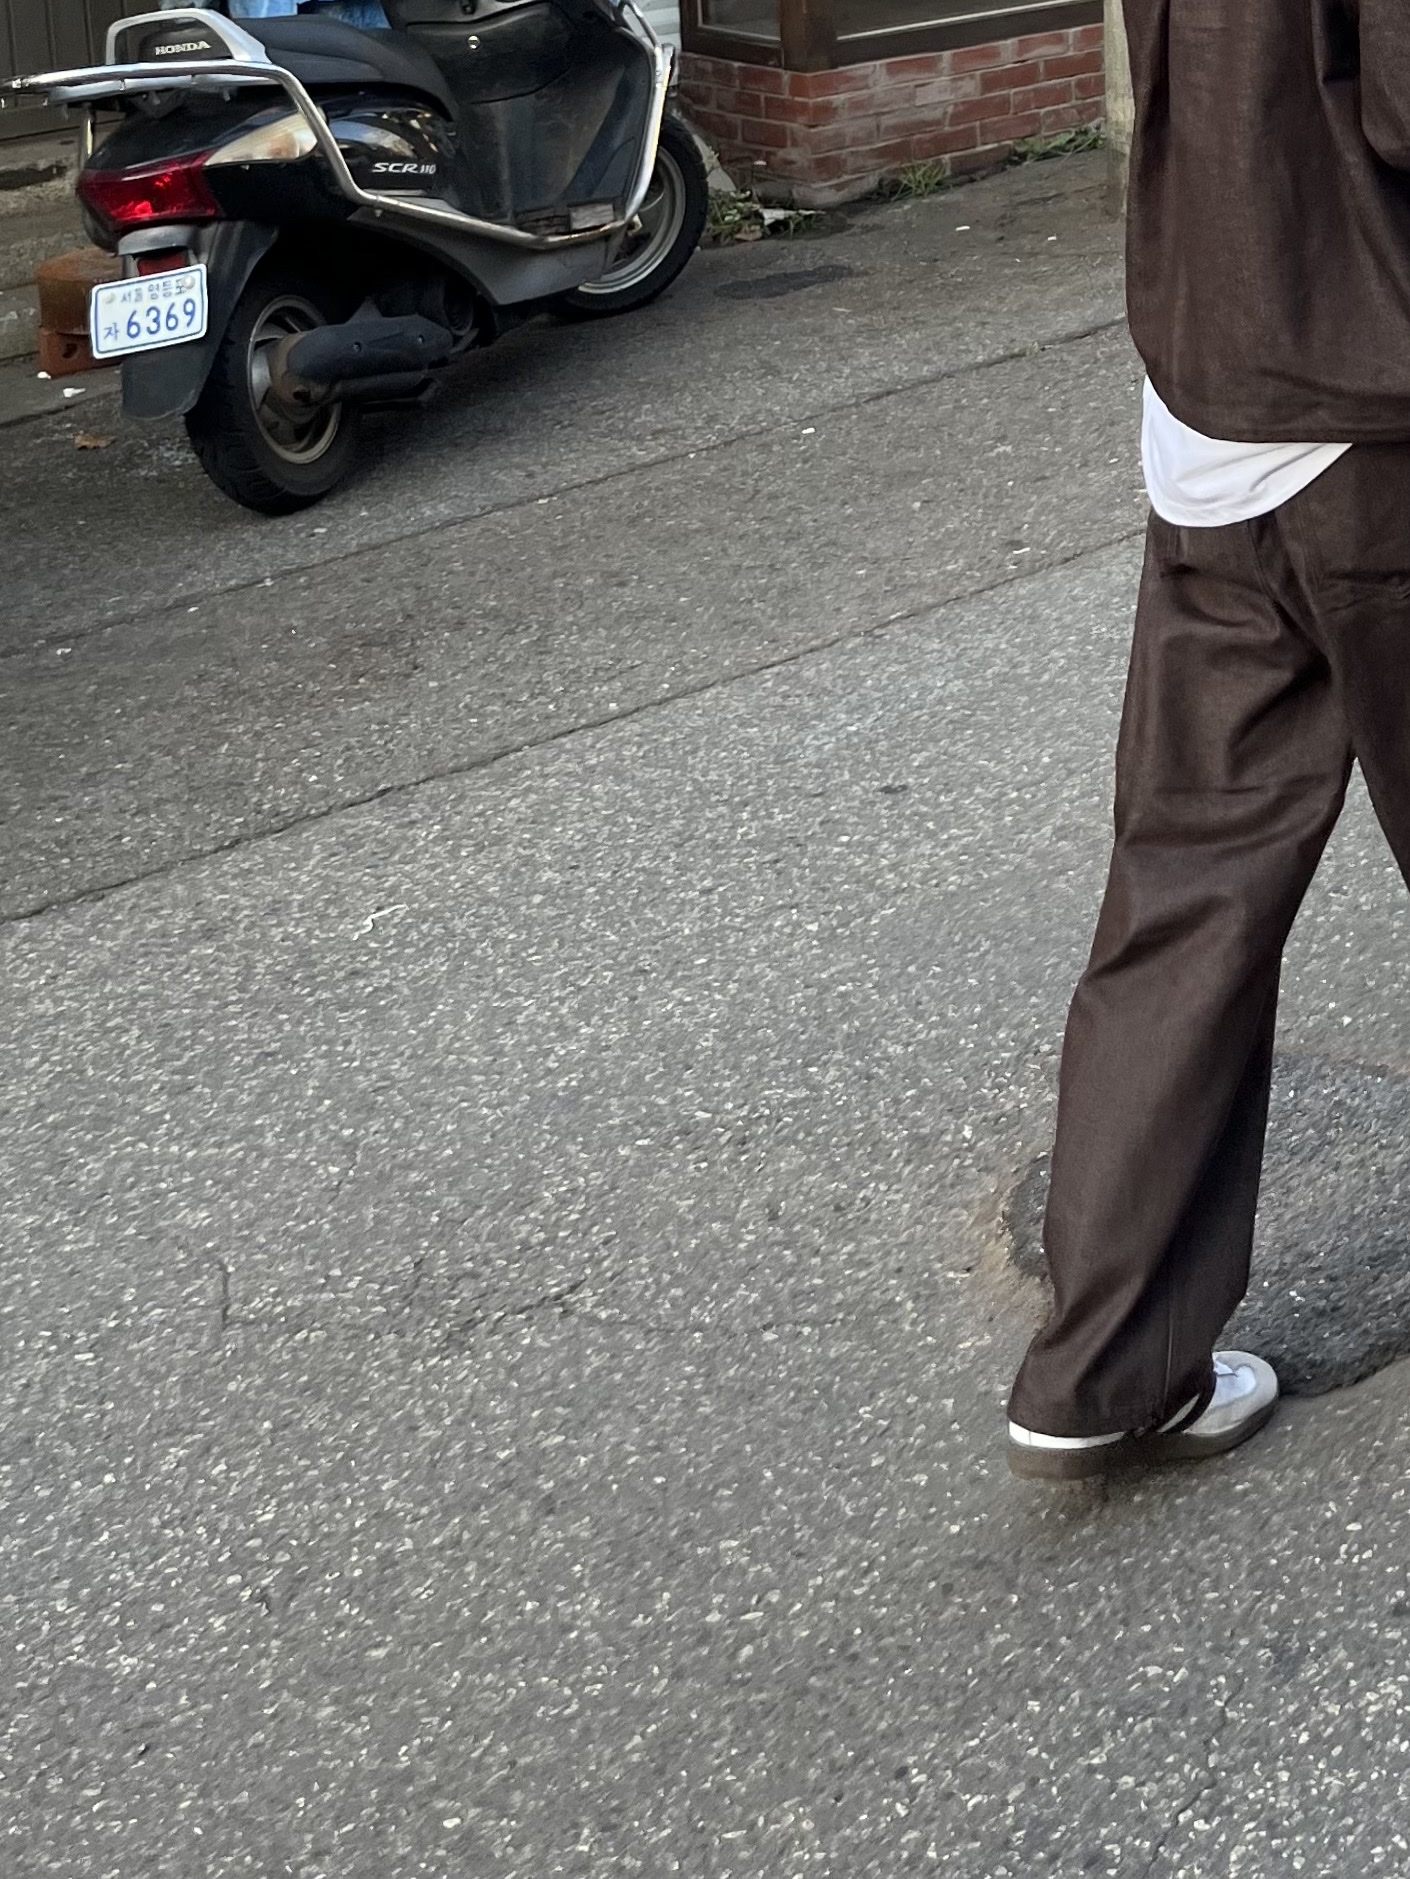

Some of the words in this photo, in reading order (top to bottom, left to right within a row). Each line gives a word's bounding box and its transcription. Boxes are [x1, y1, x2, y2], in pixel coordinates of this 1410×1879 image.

[155, 40, 212, 56] HONDA
[372, 162, 418, 174] SCR
[104, 322, 119, 341] 자
[126, 298, 196, 339] 6369
